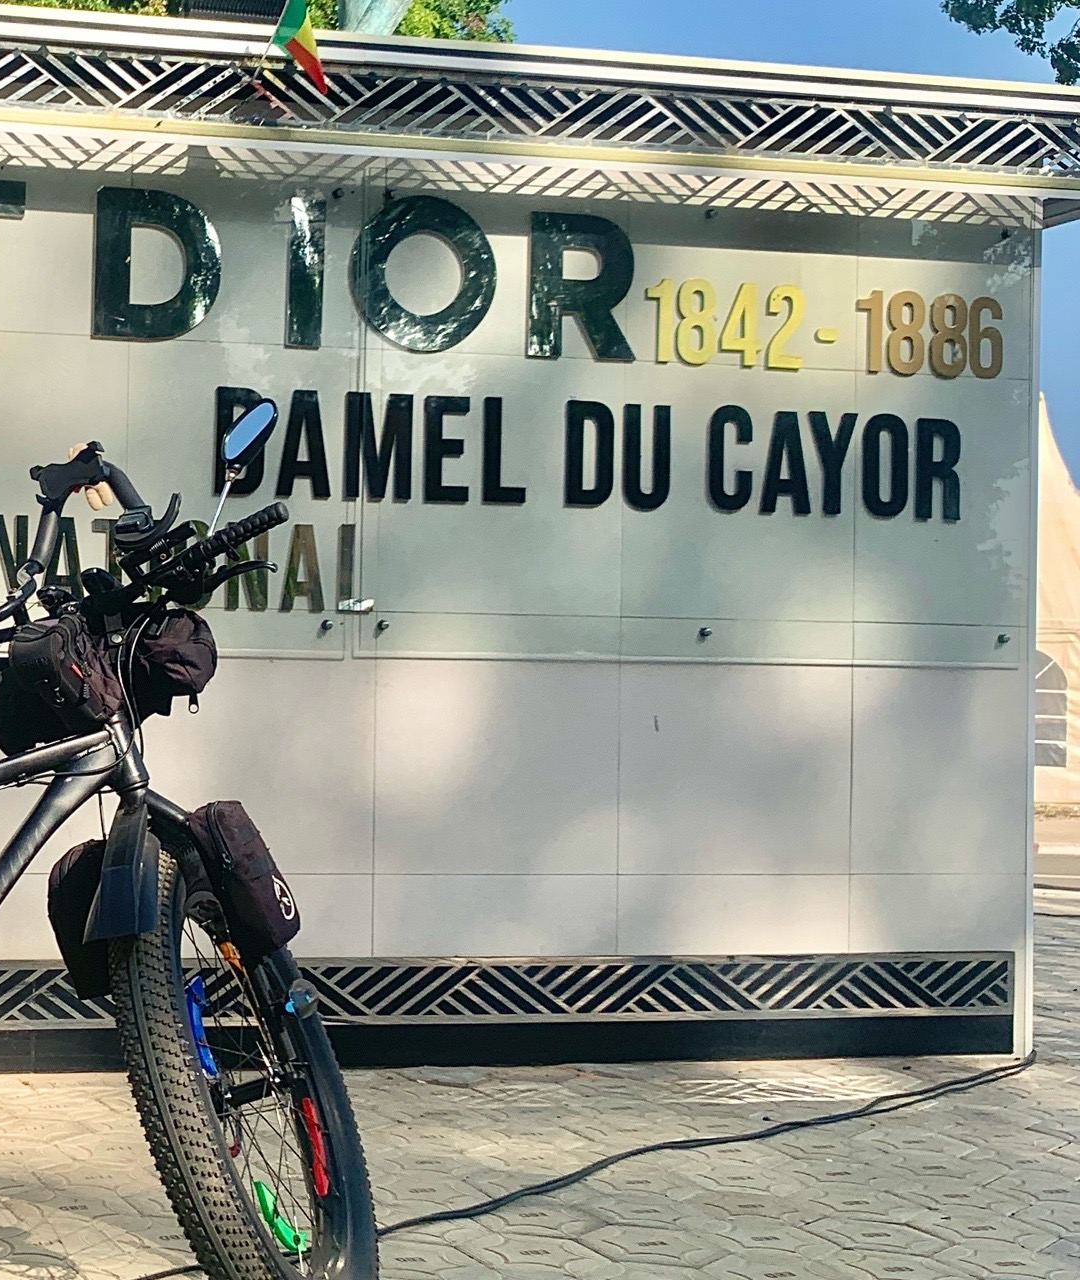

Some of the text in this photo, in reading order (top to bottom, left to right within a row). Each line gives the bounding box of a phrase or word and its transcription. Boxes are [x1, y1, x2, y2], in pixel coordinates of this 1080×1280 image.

[91, 185, 636, 363] DIOR
[645, 275, 806, 371] 1842
[856, 288, 1004, 380] 1886
[213, 385, 962, 522] DAMEL DU CAYOR
